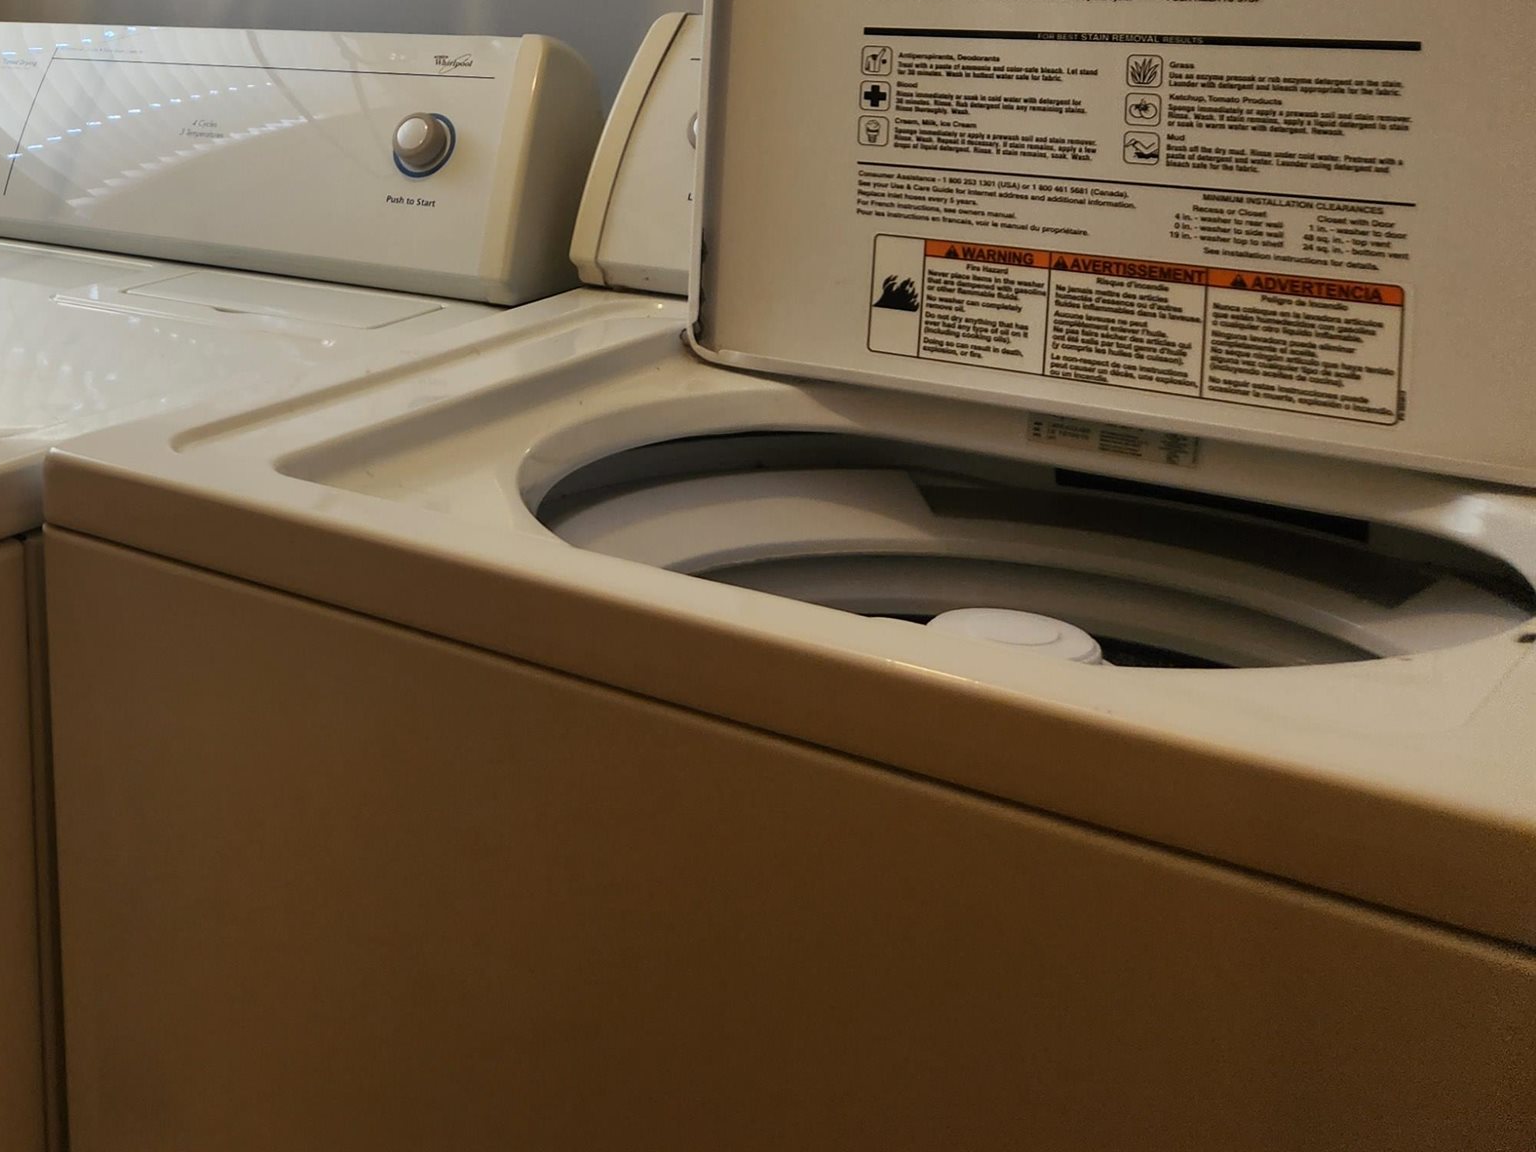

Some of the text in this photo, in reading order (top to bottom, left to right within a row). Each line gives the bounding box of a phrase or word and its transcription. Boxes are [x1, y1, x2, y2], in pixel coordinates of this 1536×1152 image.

[1081, 33, 1109, 41] STAIN
[1112, 33, 1159, 43] REMOVAL
[1162, 36, 1204, 44] RESULTS
[435, 55, 473, 69] Whirlpool
[957, 54, 1000, 62] Deodorants
[1169, 61, 1195, 69] Grass
[896, 81, 918, 89] Blood
[1207, 94, 1240, 104] Tomato
[1242, 97, 1282, 106] Products
[1166, 134, 1185, 142] Mud
[858, 170, 895, 179] Consumer
[896, 173, 936, 183] Assistance
[386, 195, 436, 207] Push to Start
[962, 247, 1034, 265] WARNING
[966, 264, 1009, 274] Fire Hazard
[1070, 258, 1205, 283] AVERTISSEMENT
[1251, 276, 1383, 301] ADVERTENCIA
